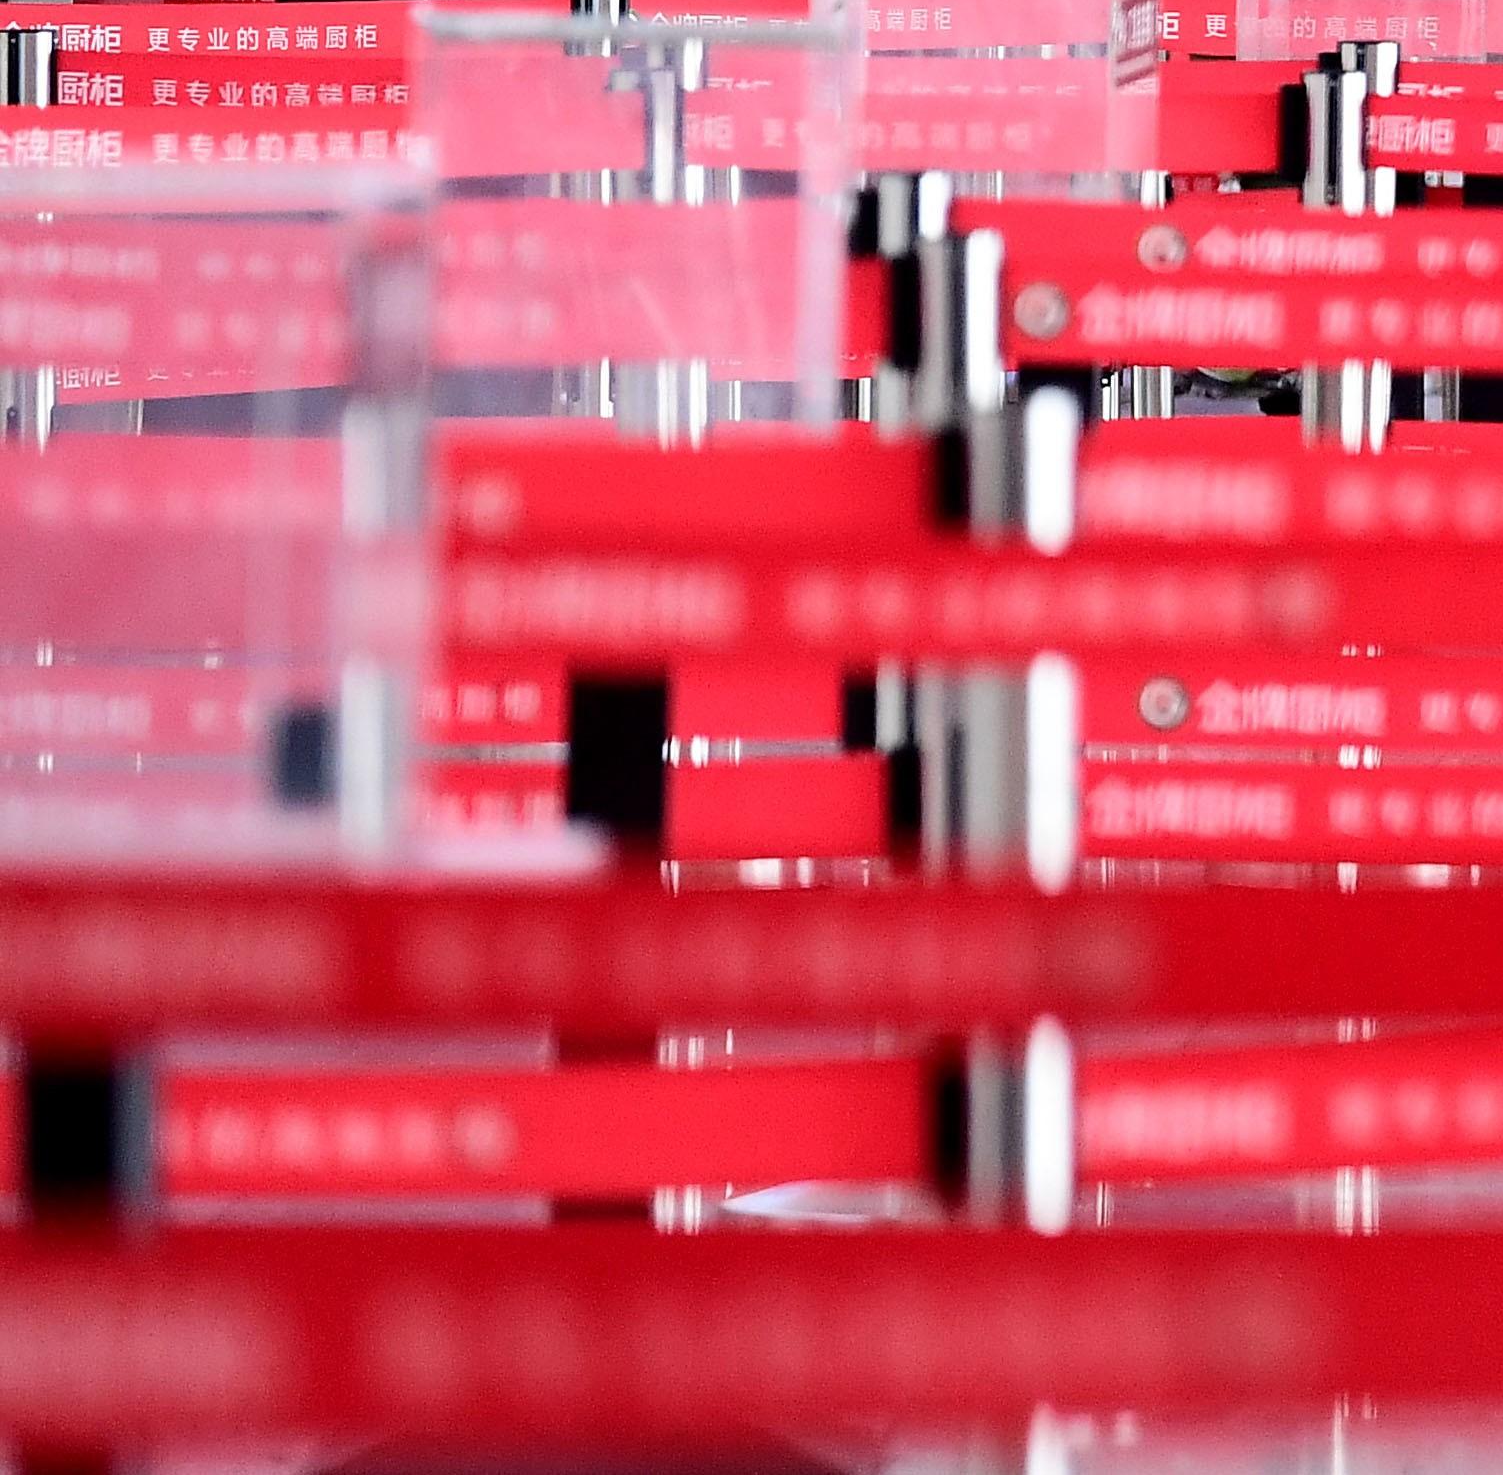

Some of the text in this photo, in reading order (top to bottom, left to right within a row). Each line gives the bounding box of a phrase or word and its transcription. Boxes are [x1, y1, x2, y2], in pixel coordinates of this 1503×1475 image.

[147, 24, 378, 52] 更专业的高端厨柜
